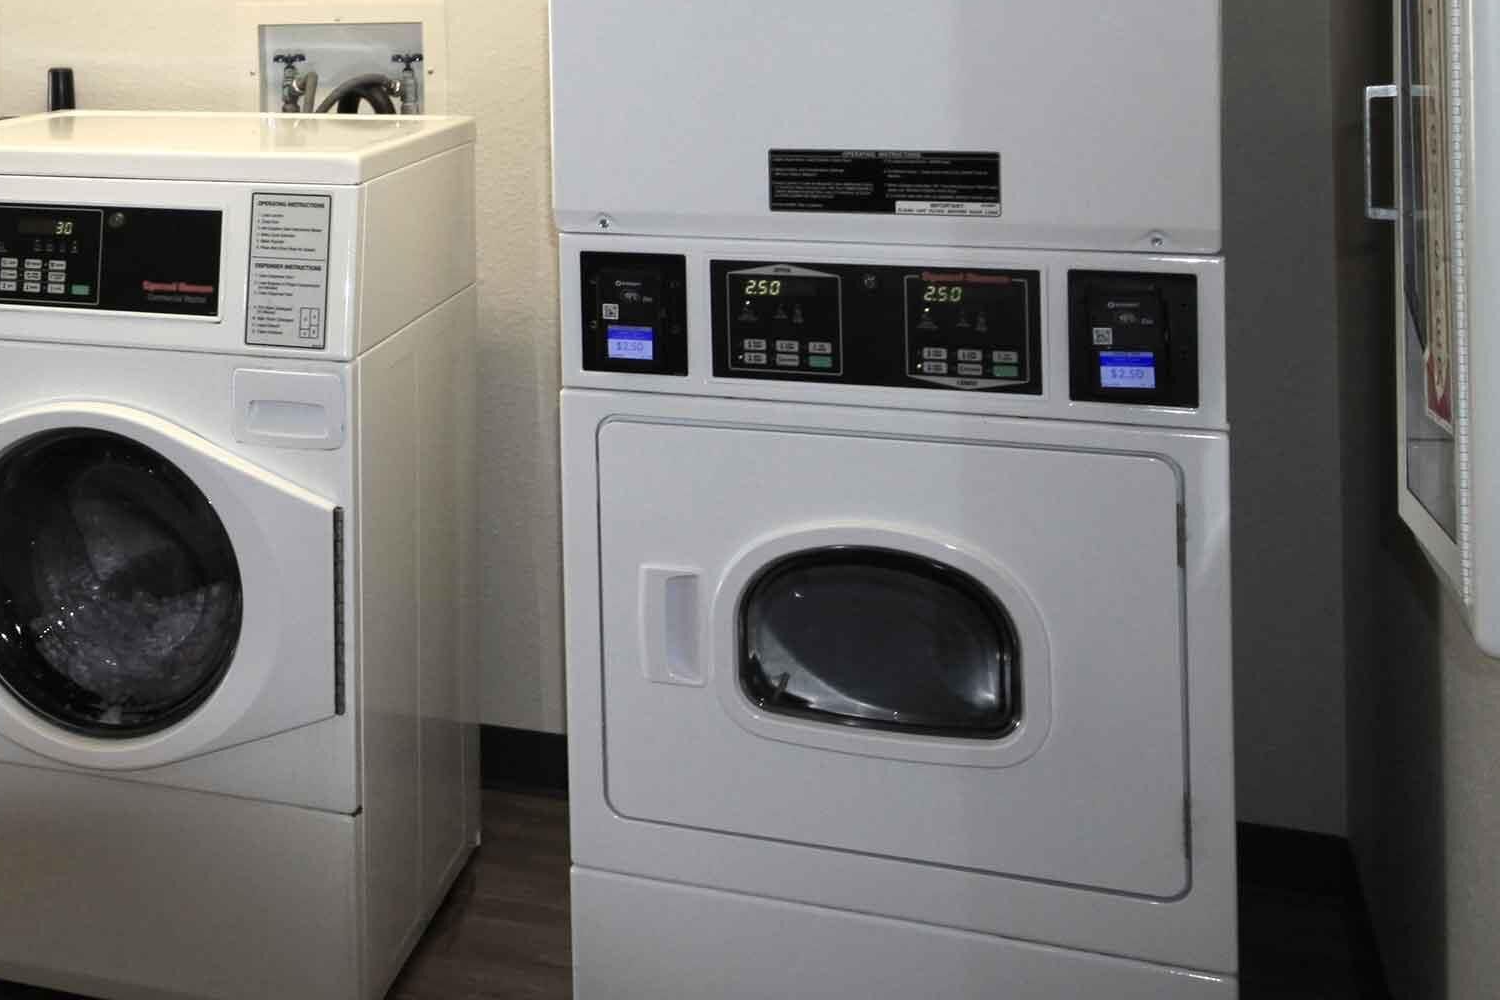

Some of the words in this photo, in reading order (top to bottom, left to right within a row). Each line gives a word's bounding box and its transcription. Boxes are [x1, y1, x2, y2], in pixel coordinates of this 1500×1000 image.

[54, 221, 74, 235] 30
[745, 279, 781, 296] 2.50
[923, 285, 963, 302] 2.50
